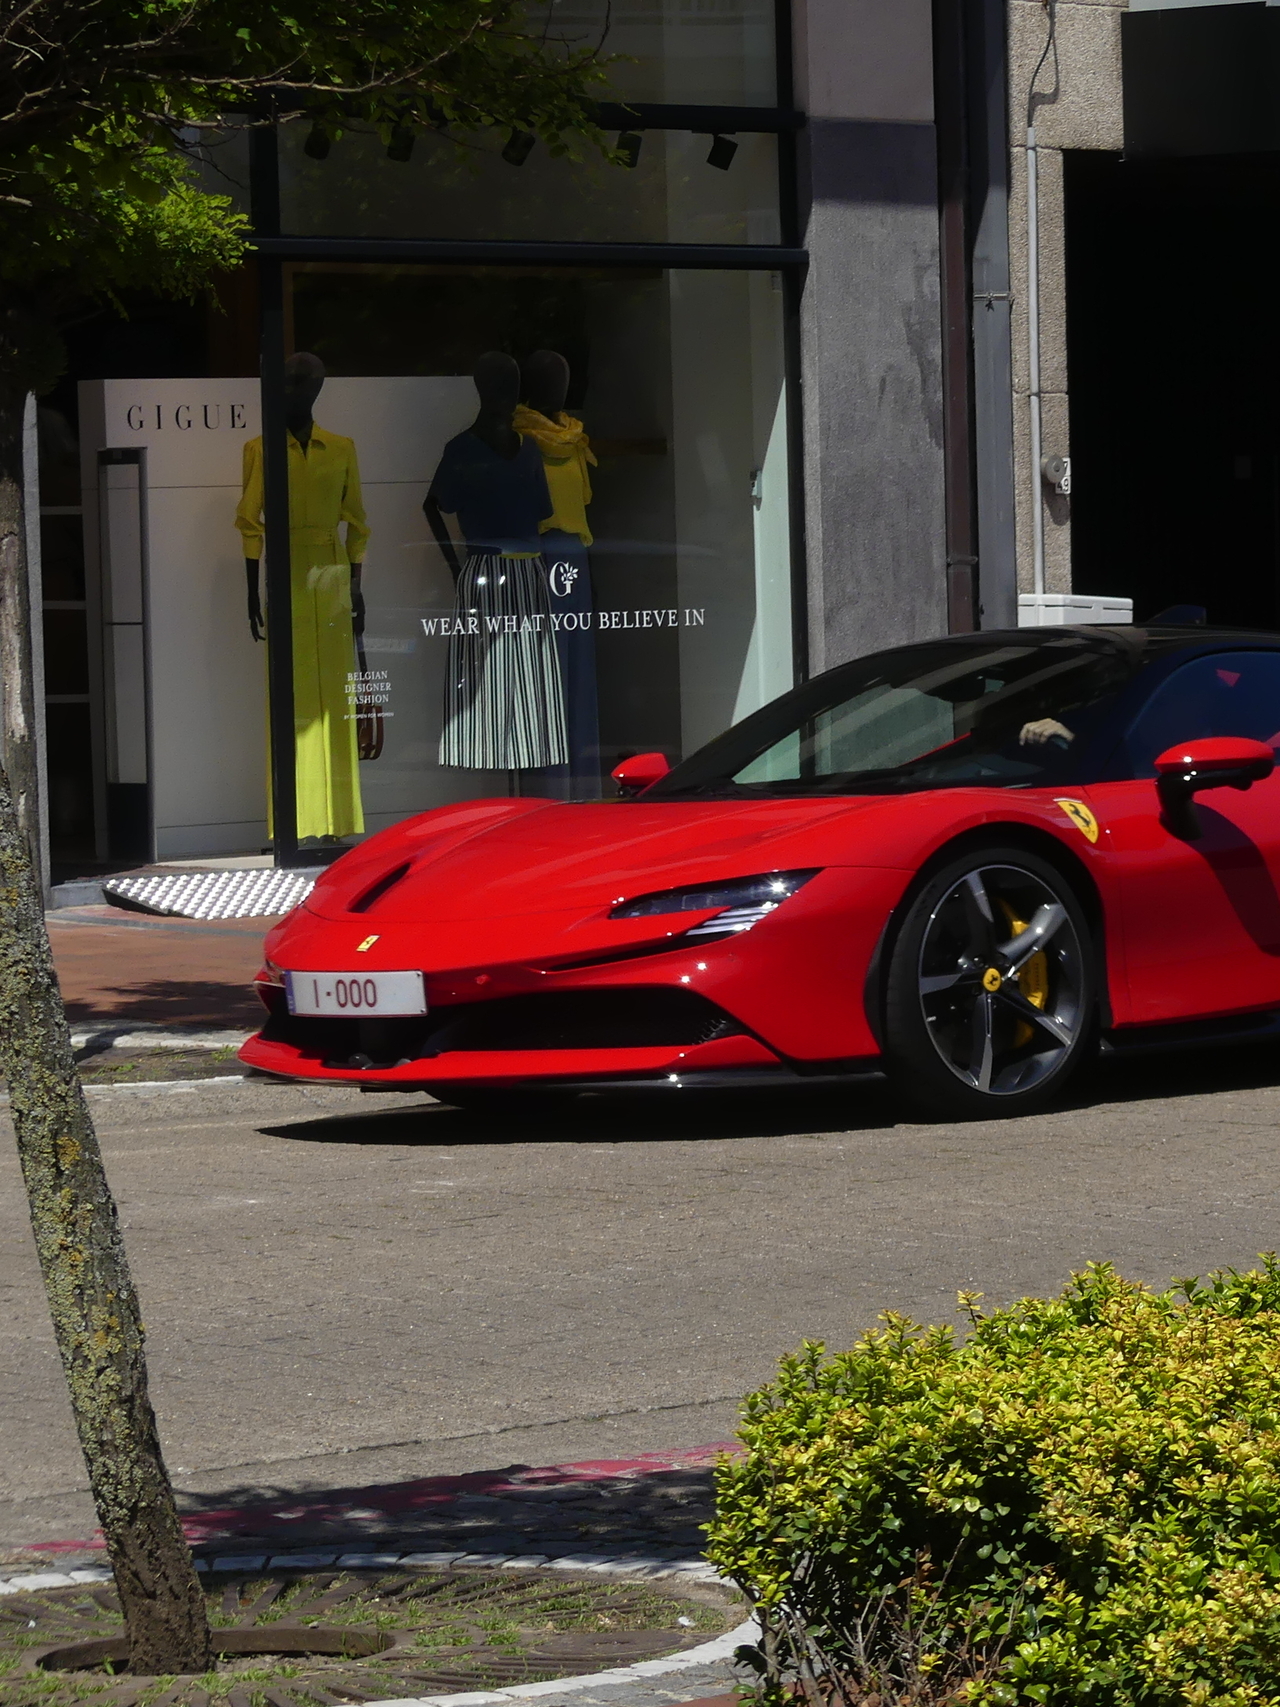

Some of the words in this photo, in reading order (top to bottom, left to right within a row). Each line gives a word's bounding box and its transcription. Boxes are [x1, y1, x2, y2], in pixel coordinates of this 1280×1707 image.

[127, 404, 247, 431] GIGUE
[421, 617, 480, 636] WEAR
[484, 614, 545, 634] WHAT
[550, 612, 592, 631] YOU
[599, 609, 679, 630] BELIEVE
[684, 608, 706, 626] IN
[347, 671, 388, 681] BELGIAN
[344, 682, 392, 693] DESIGNER
[347, 694, 389, 705] FASHION
